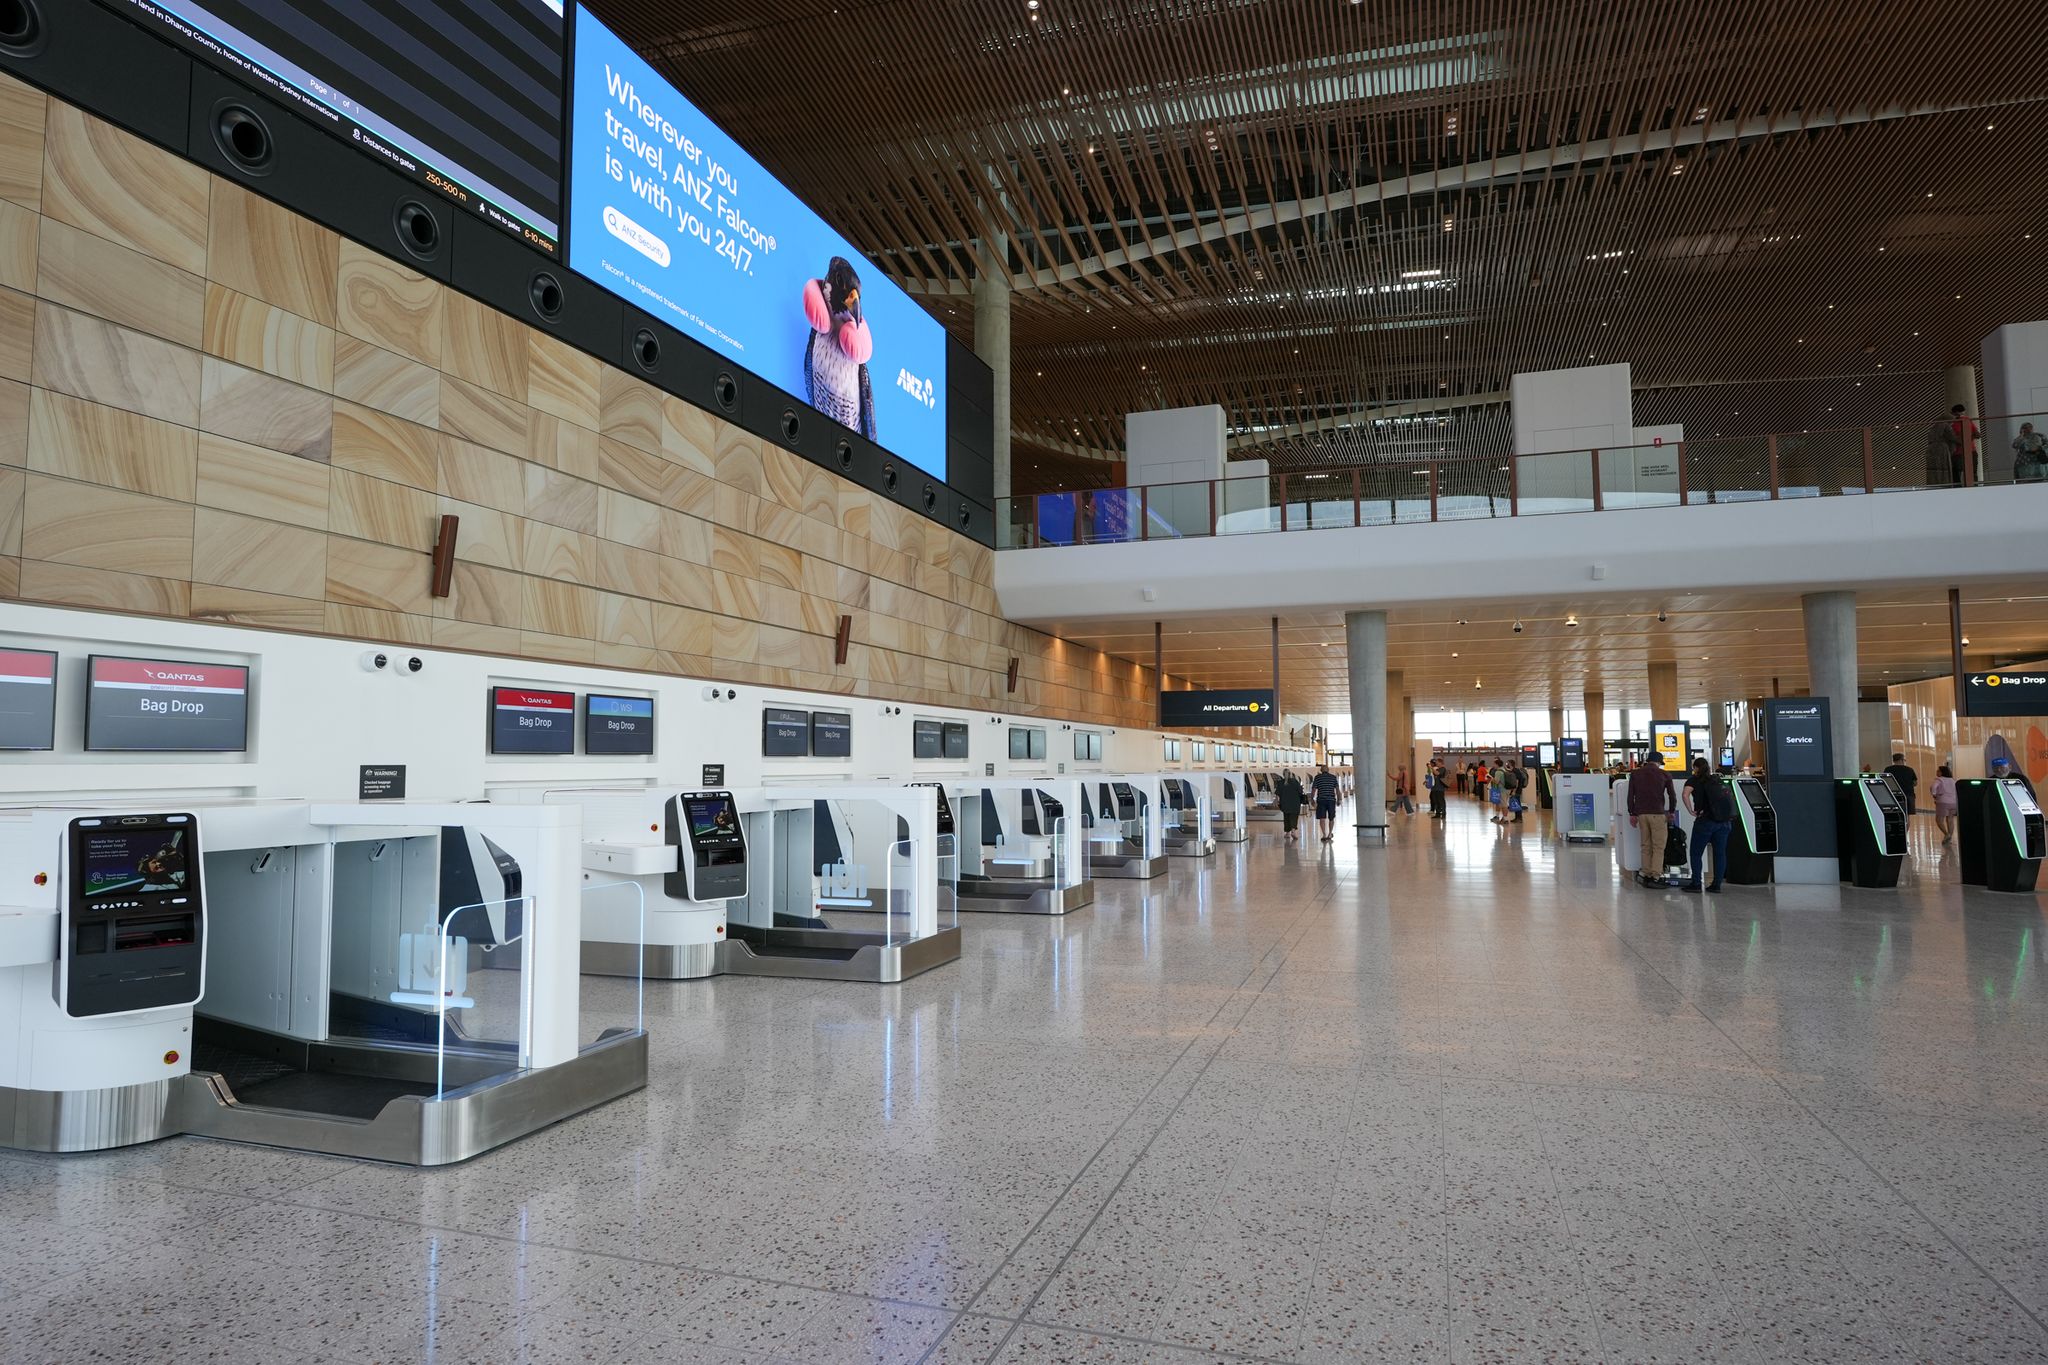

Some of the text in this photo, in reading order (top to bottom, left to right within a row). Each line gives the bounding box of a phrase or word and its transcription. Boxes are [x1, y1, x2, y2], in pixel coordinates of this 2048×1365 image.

[138, 0, 339, 121] land in Dharug Country, home of Western Sydney International
[310, 79, 328, 95] Page
[333, 92, 337, 101] 1
[342, 100, 350, 109] of
[605, 63, 737, 196] Wherever you
[362, 135, 416, 172] Distances to gates
[605, 108, 667, 181] travel,
[673, 162, 713, 212] ANZ
[426, 171, 467, 202] 250-500 m
[489, 208, 521, 233] Walk to gates
[605, 145, 753, 276] is with you 24/7.
[524, 229, 553, 252] 6-10 mins
[621, 224, 664, 260] ANZ Security
[624, 274, 631, 283] is
[630, 278, 636, 286] a
[635, 280, 663, 302] registered
[663, 297, 690, 318] trademark
[689, 313, 696, 321] of
[896, 367, 922, 402] ANZ
[157, 672, 205, 682] QANTAS
[2002, 676, 2046, 685] Bag Drop
[141, 698, 204, 715] Bag Drop
[527, 697, 552, 705] QANTAS
[519, 716, 552, 728] Bag Drop
[608, 720, 635, 731] Bag Drop
[778, 729, 787, 737] Bag
